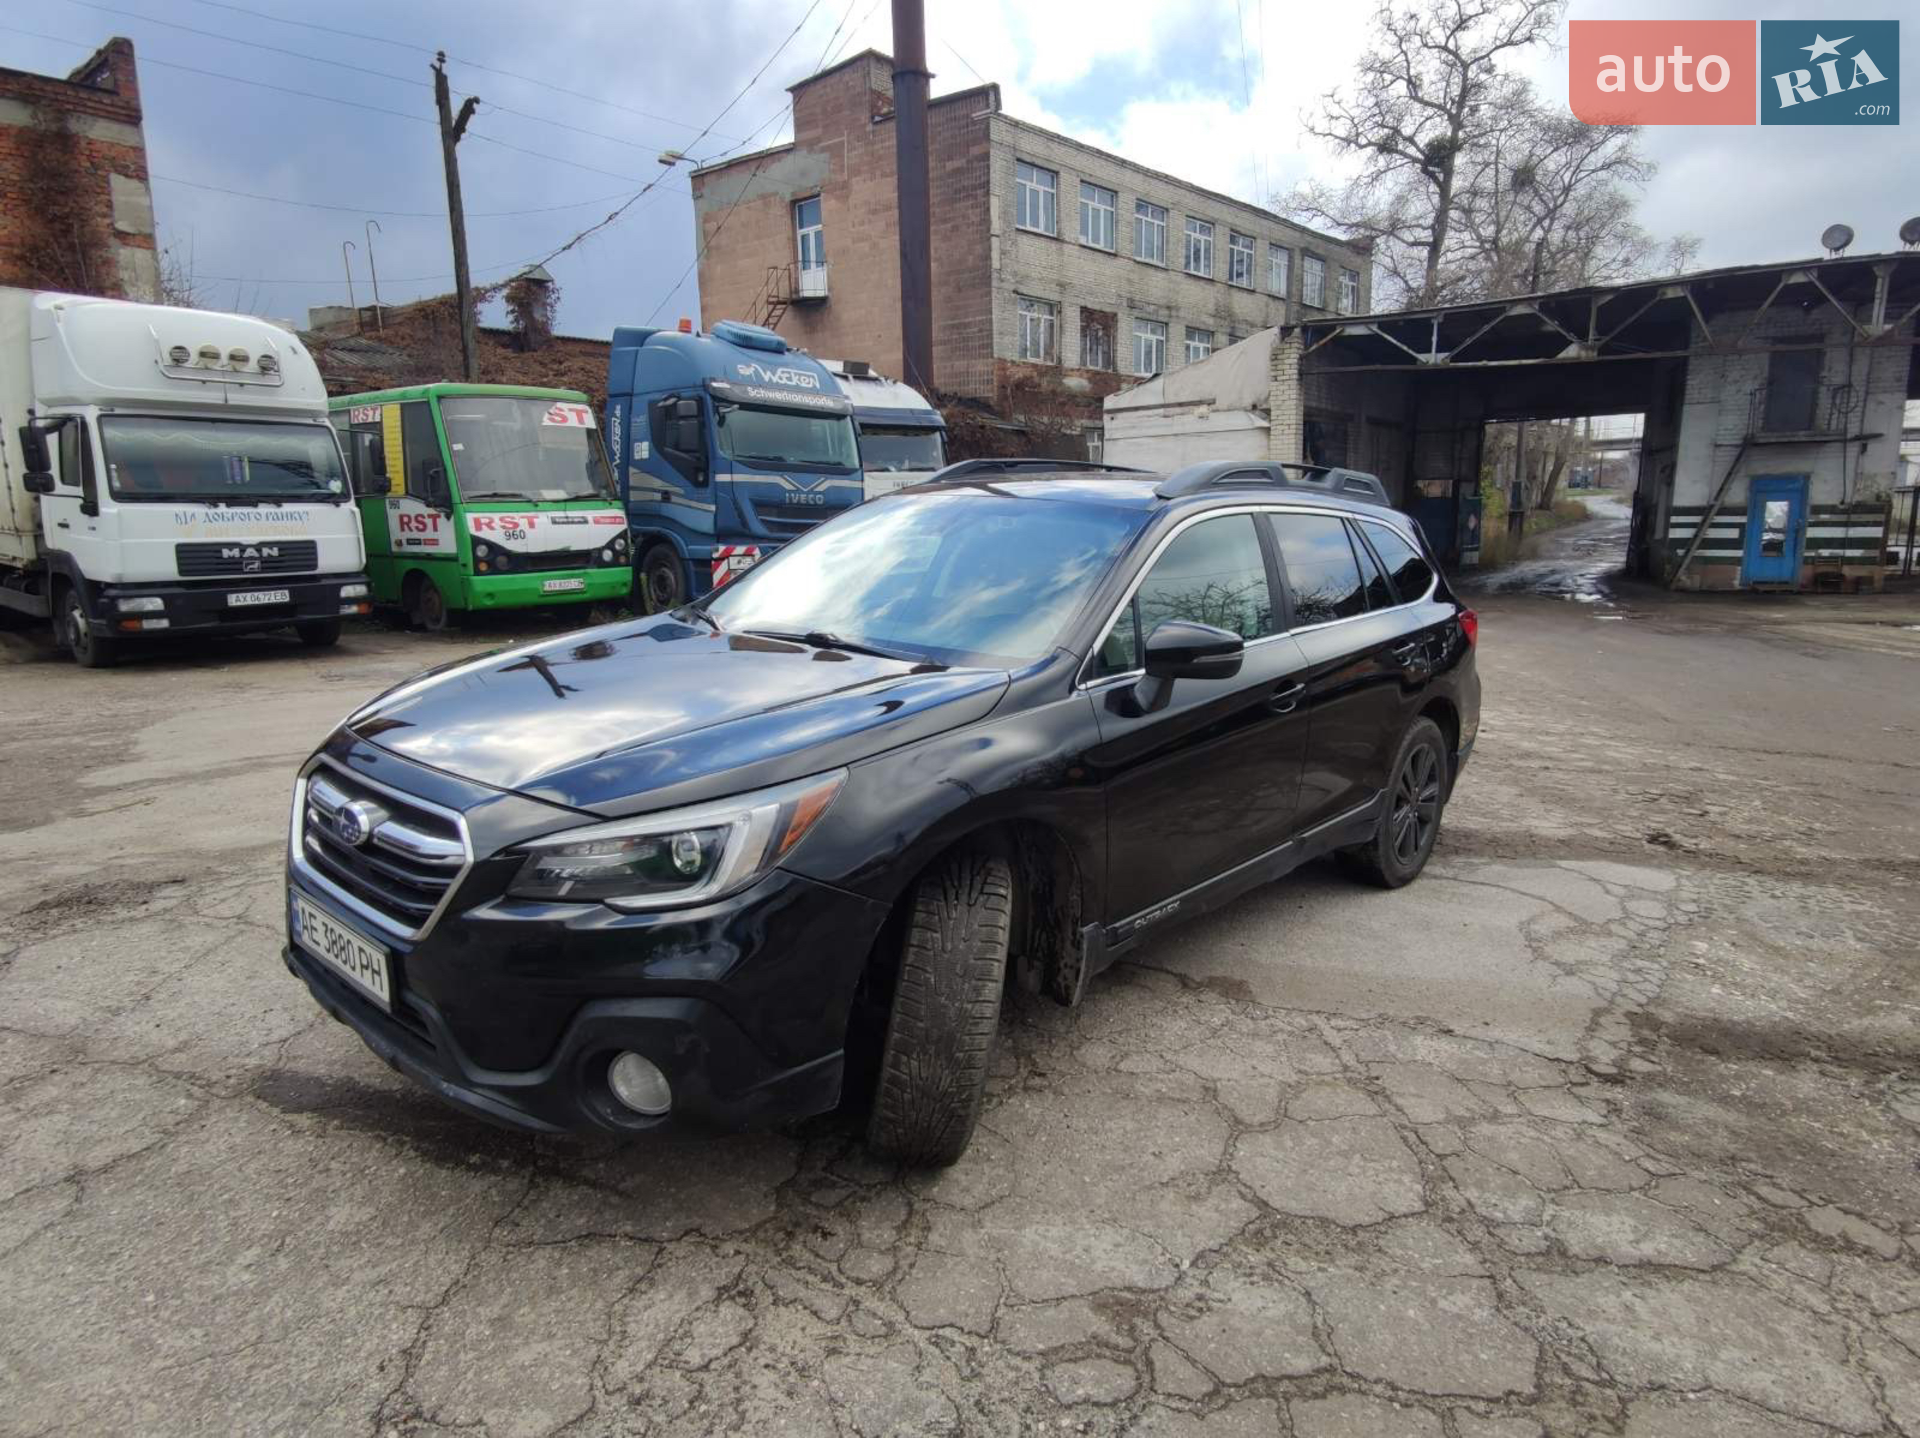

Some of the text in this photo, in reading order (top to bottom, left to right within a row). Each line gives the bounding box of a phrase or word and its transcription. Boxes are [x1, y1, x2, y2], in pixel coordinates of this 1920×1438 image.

[352, 407, 380, 422] RST
[785, 493, 824, 505] IVECO
[399, 513, 442, 532] RST
[472, 515, 539, 532] RST
[504, 529, 526, 540] 960
[221, 547, 279, 559] MAN
[301, 908, 384, 992] AE 3880 PH
